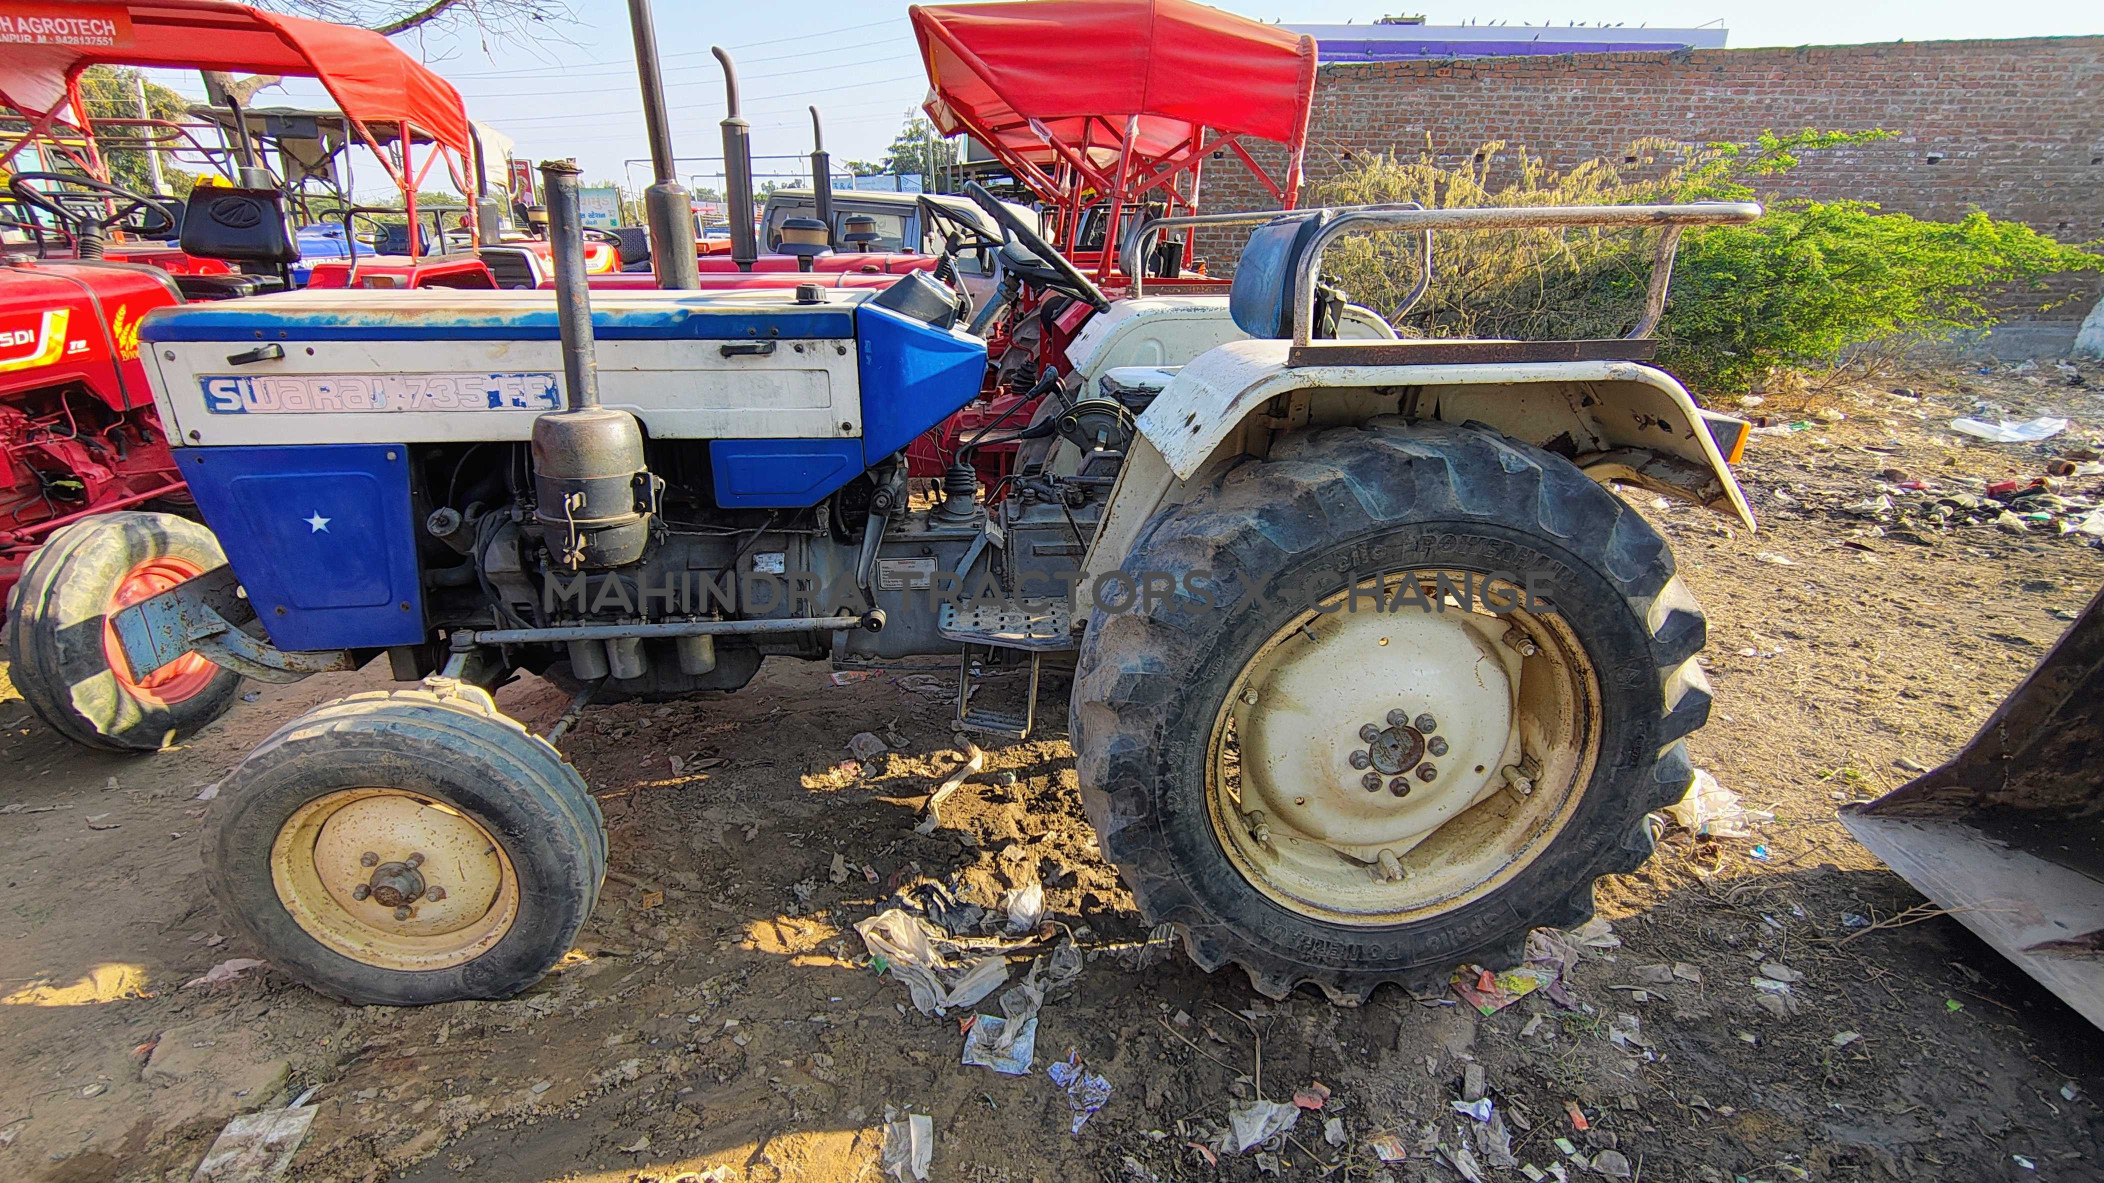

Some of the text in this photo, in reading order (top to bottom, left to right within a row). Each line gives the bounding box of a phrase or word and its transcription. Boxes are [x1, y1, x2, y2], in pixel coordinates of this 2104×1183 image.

[0, 16, 116, 36] H AGROTECH
[55, 35, 113, 46] 9428137551
[403, 377, 489, 409] 735
[498, 376, 556, 408] FE
